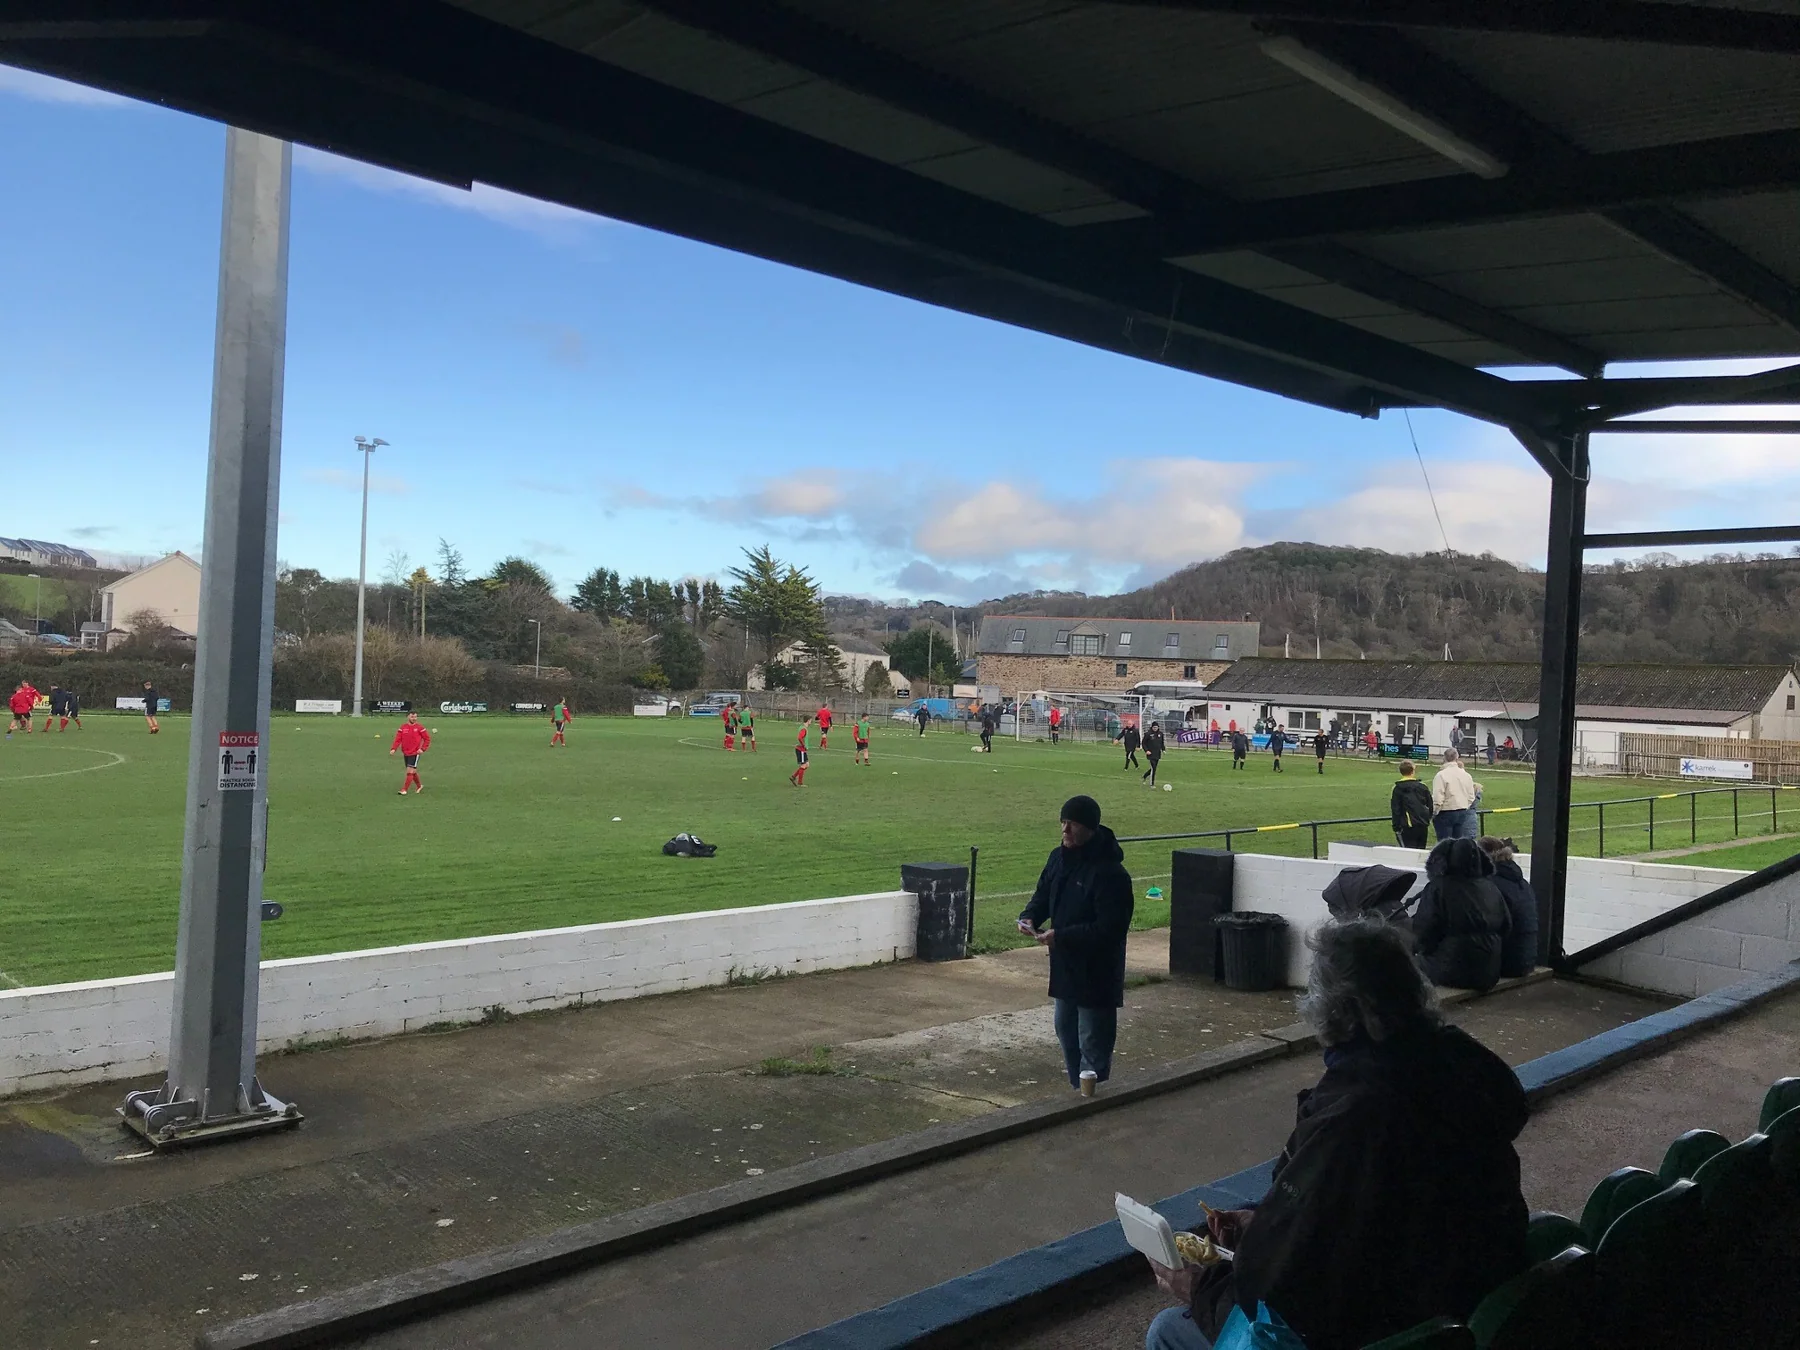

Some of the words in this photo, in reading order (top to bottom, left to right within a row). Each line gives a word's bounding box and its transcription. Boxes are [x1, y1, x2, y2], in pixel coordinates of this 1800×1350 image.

[440, 701, 473, 713] Carlsberg
[222, 735, 258, 744] NOTICE
[1182, 731, 1213, 743] TRIBUTE
